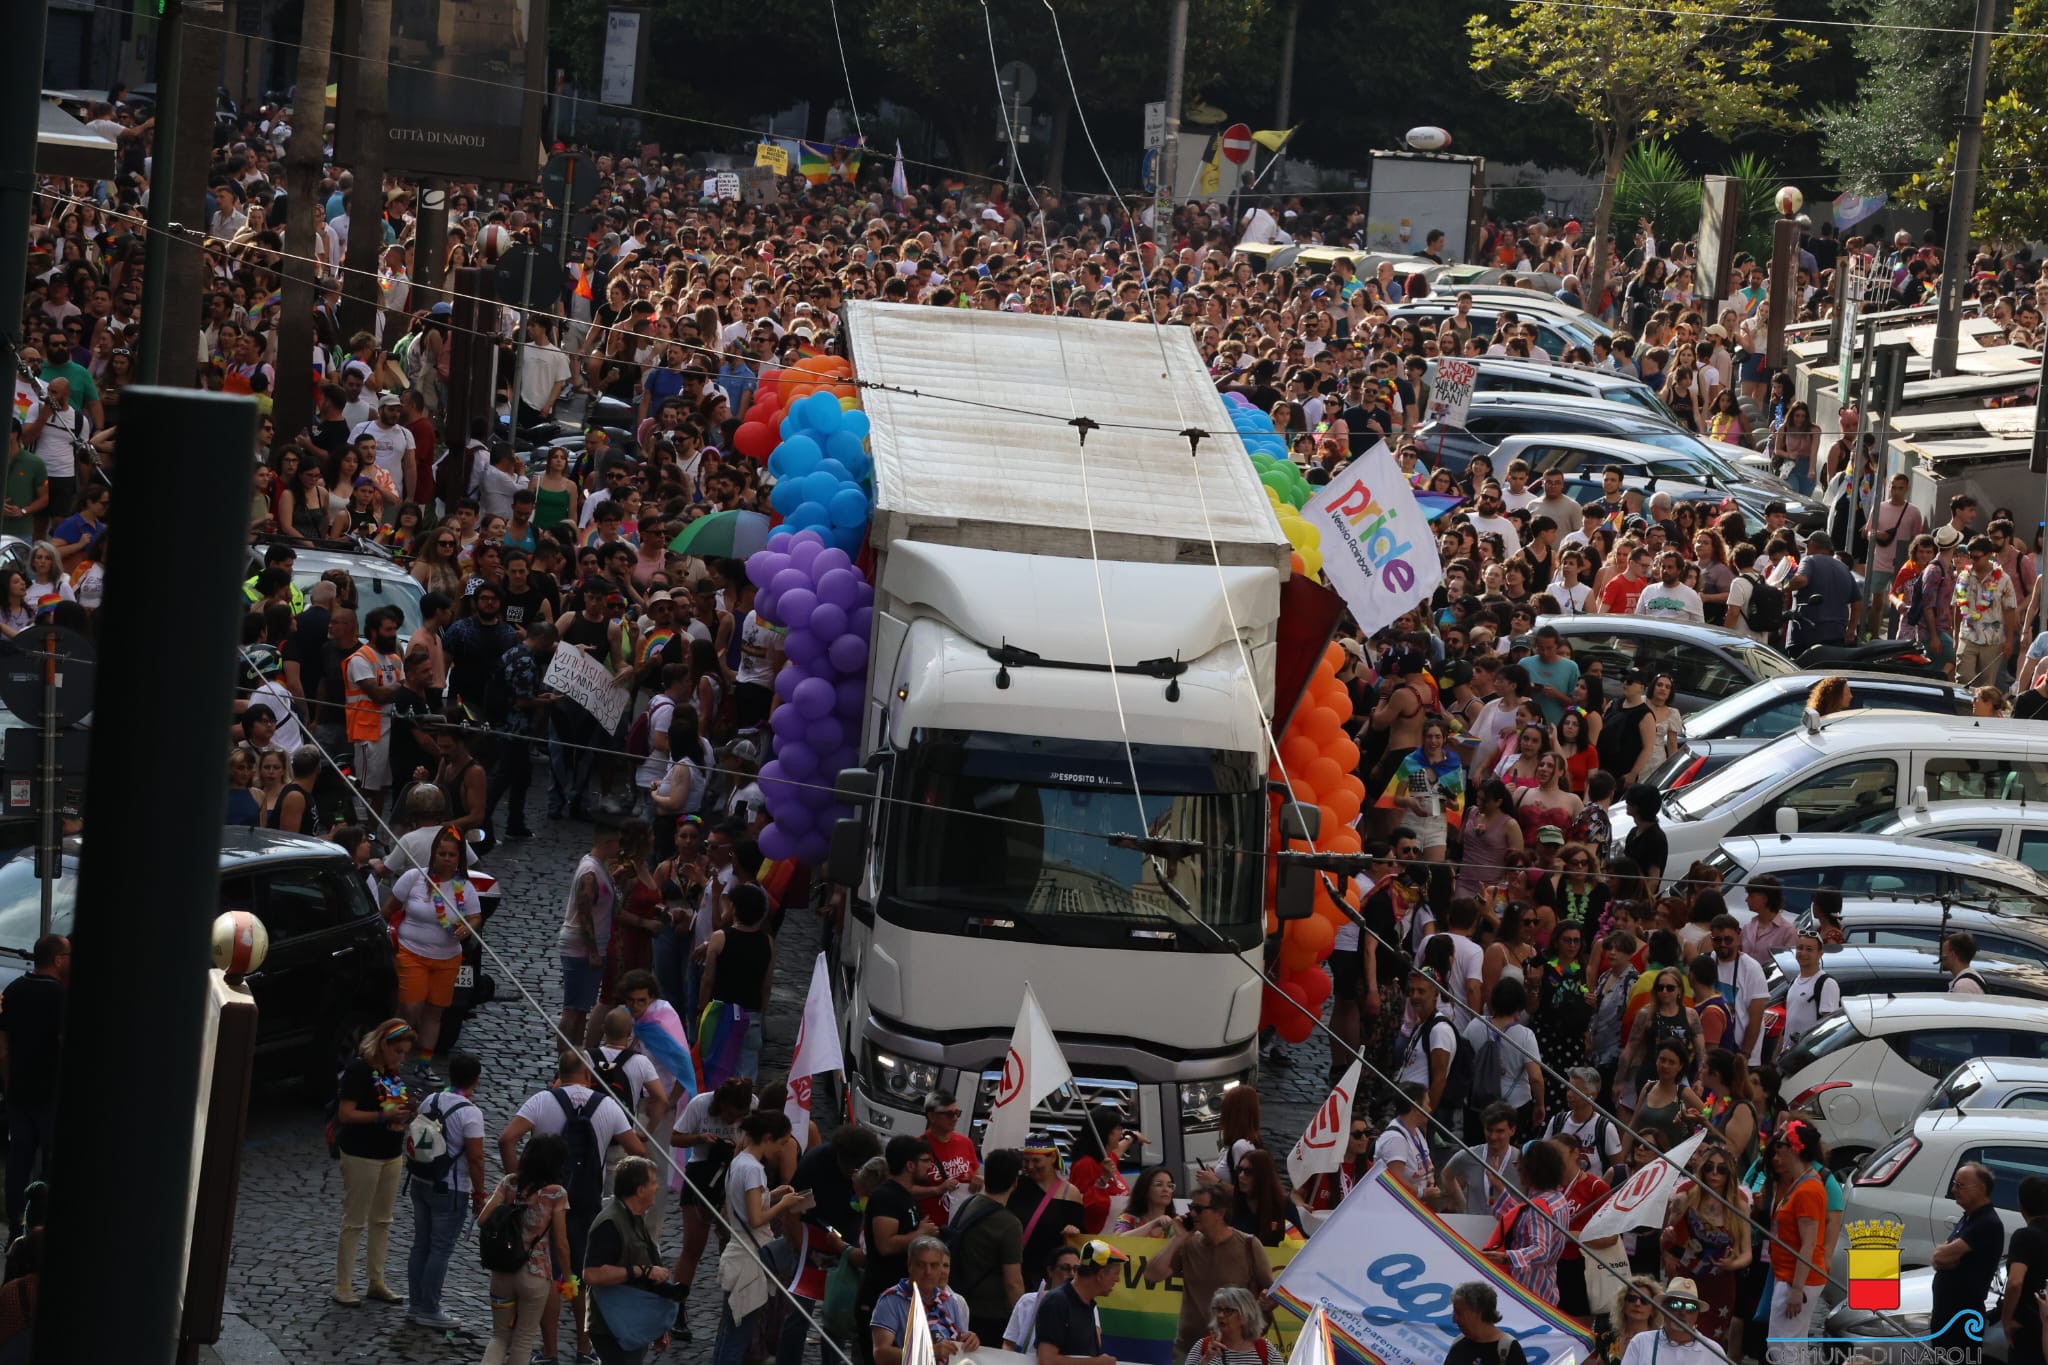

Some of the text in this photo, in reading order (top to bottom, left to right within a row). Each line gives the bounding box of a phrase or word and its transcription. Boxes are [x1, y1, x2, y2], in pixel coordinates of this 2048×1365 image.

[389, 128, 485, 147] CITTÀ DI NAPOLI
[1438, 368, 1471, 385] SANGUE
[1435, 387, 1463, 406] MANI
[1324, 479, 1415, 593] pride
[1348, 536, 1374, 578] Rainbow
[1059, 772, 1096, 783] ESPOSITO
[1363, 1326, 1401, 1359] parenti,
[1370, 1343, 1392, 1361] gay,
